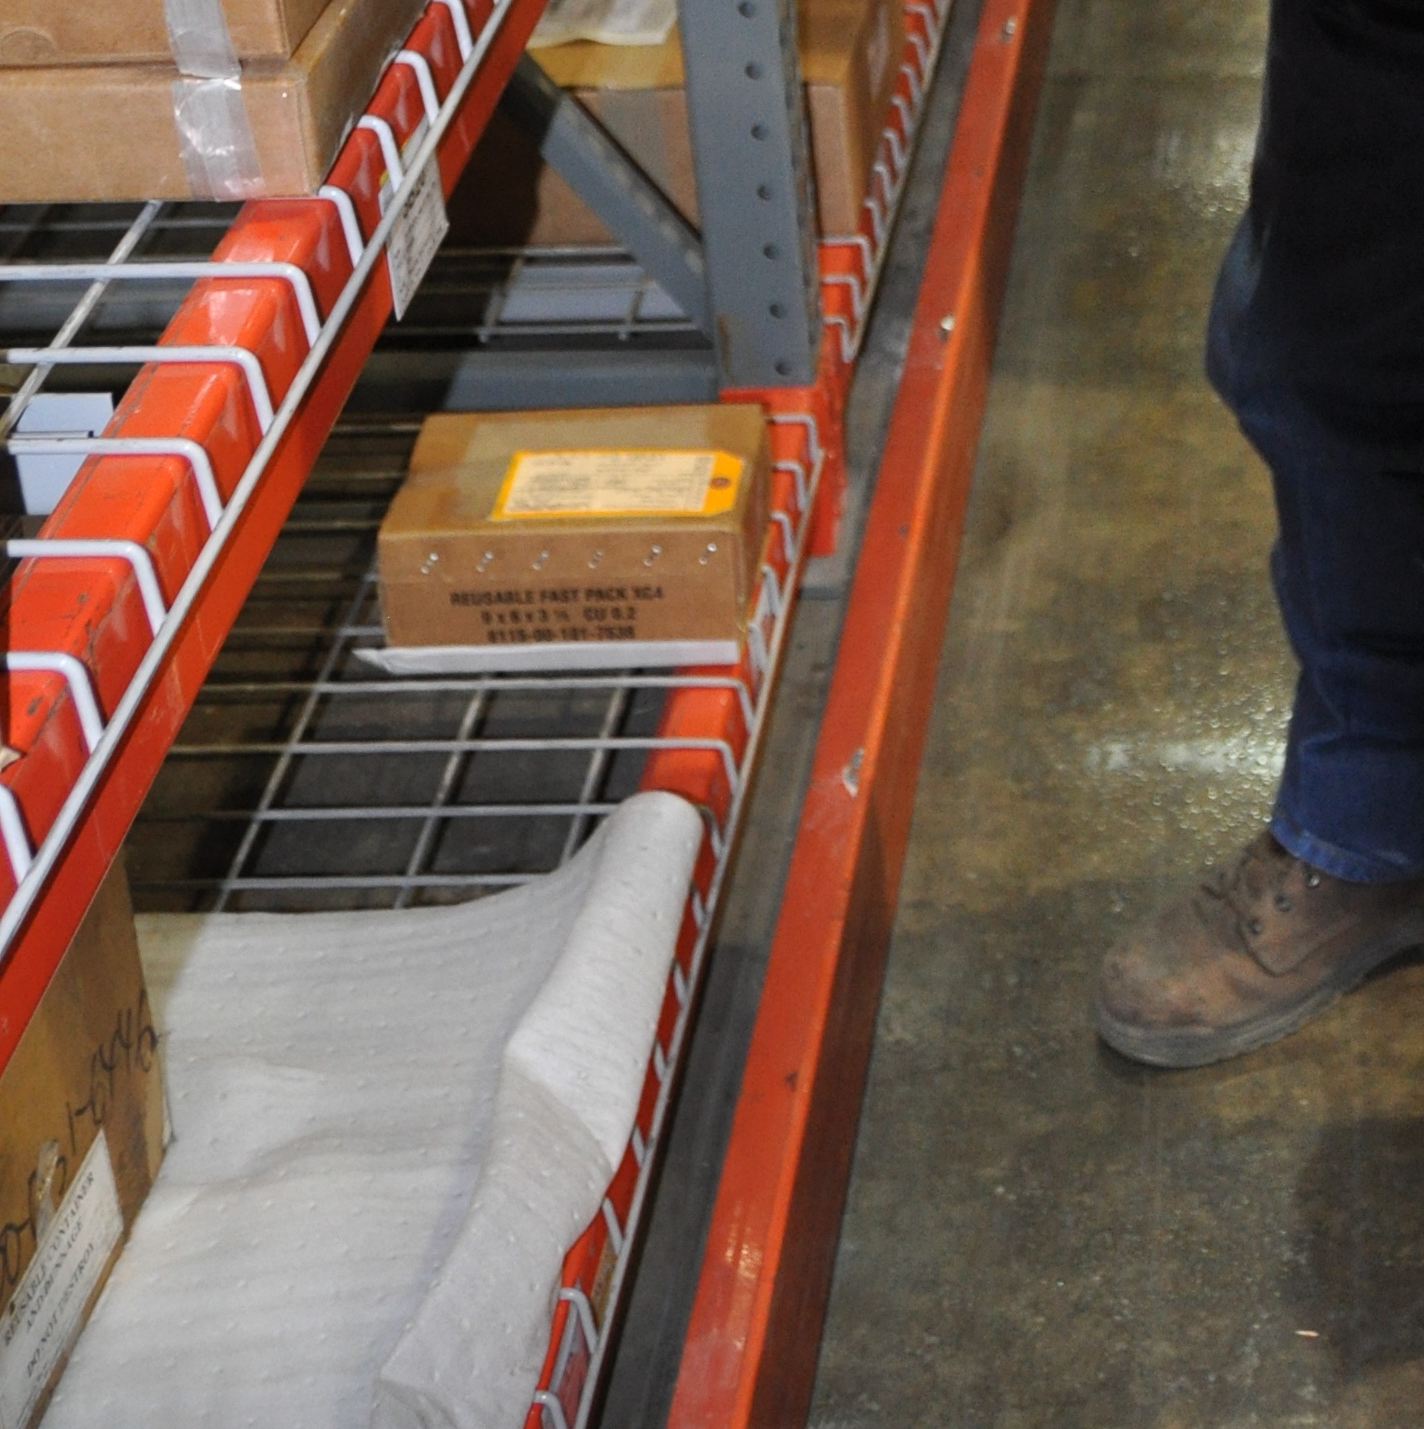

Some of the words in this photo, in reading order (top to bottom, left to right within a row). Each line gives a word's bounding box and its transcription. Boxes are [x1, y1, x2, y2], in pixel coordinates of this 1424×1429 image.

[450, 589, 535, 606] REUSABLE
[540, 588, 579, 603] FAST
[584, 587, 628, 602] PACK
[48, 1169, 95, 1262] CONTAINER
